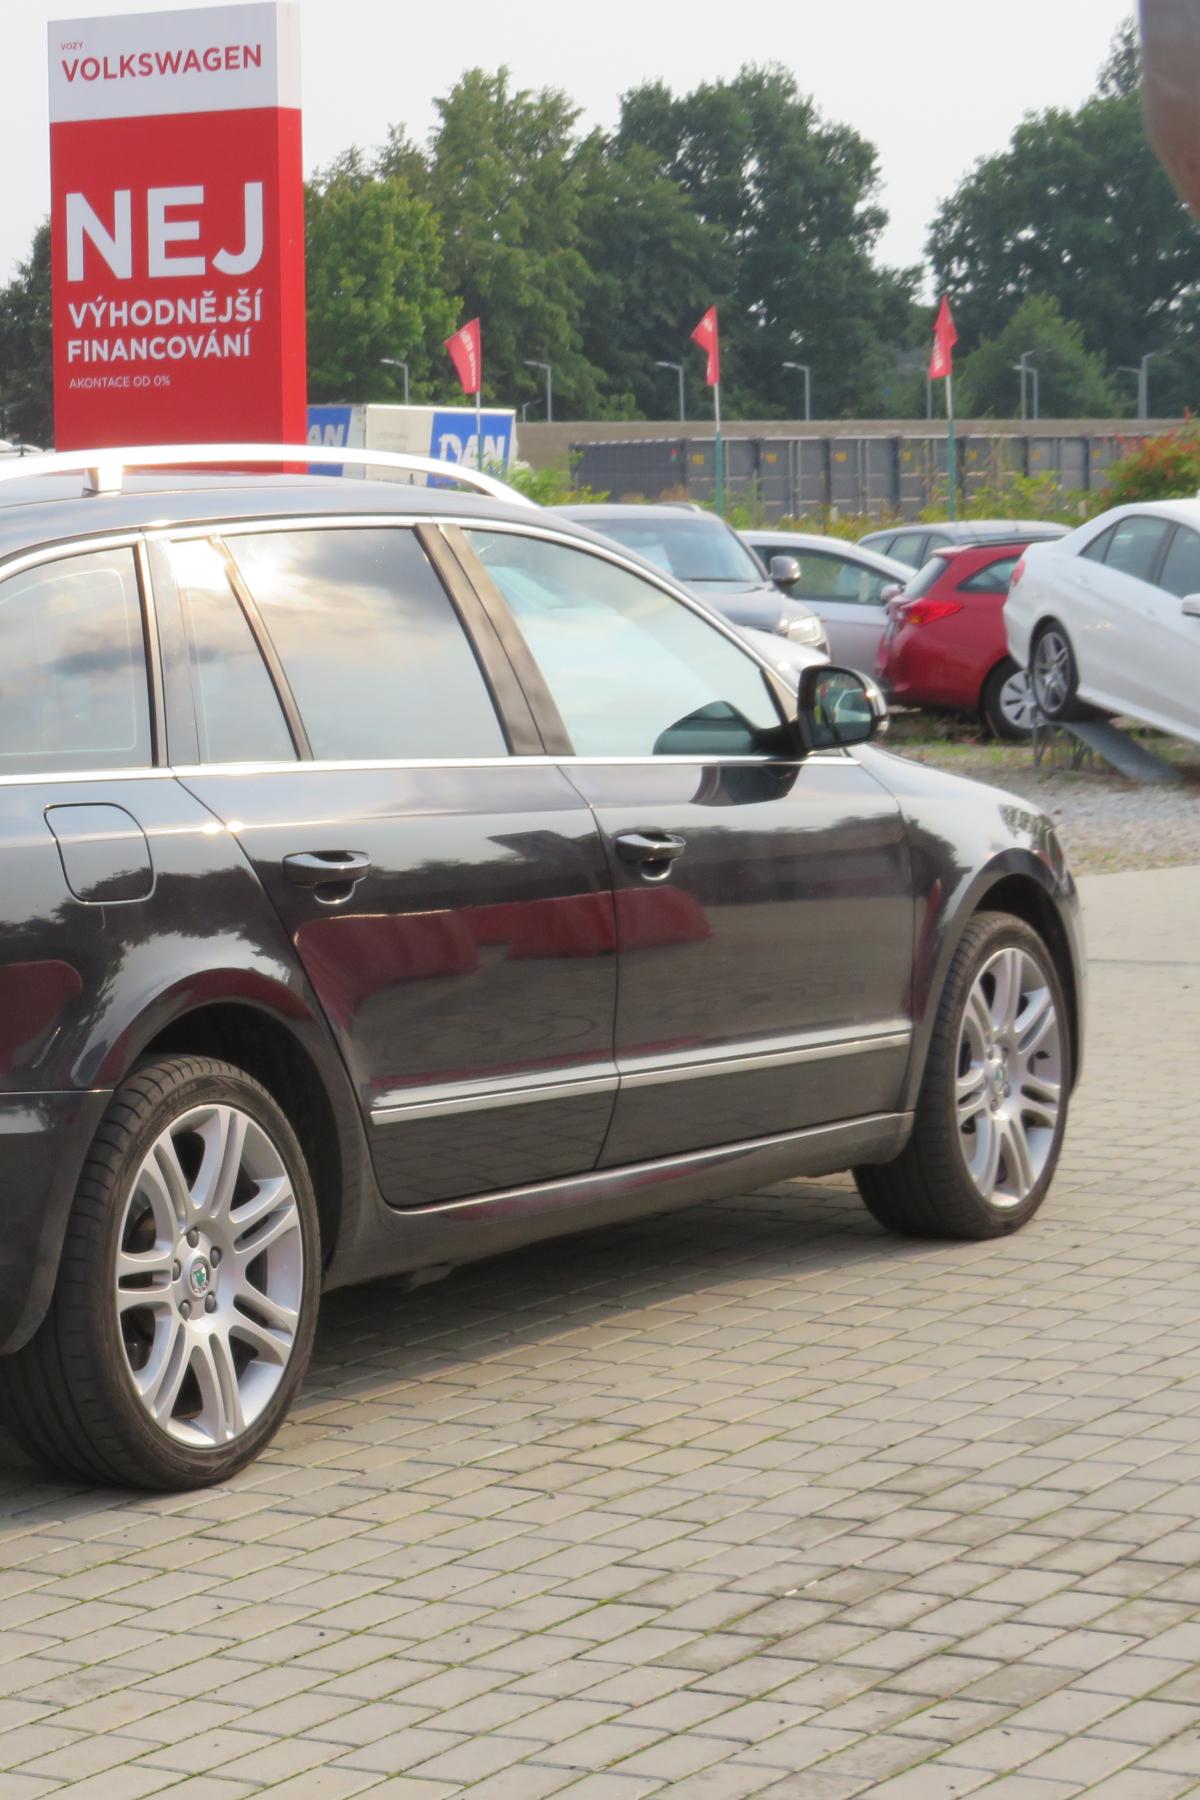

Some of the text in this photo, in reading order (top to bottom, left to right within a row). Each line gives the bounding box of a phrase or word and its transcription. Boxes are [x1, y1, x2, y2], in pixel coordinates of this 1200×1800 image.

[60, 42, 84, 51] VOZY
[61, 43, 262, 83] VOLKSWAGEN
[65, 181, 264, 283] NEJ
[67, 287, 264, 330] VÝHODNĚJŠÍ
[66, 327, 253, 363] FINANCOVÁNÍ
[69, 374, 171, 389] AKONTACE OD 0%
